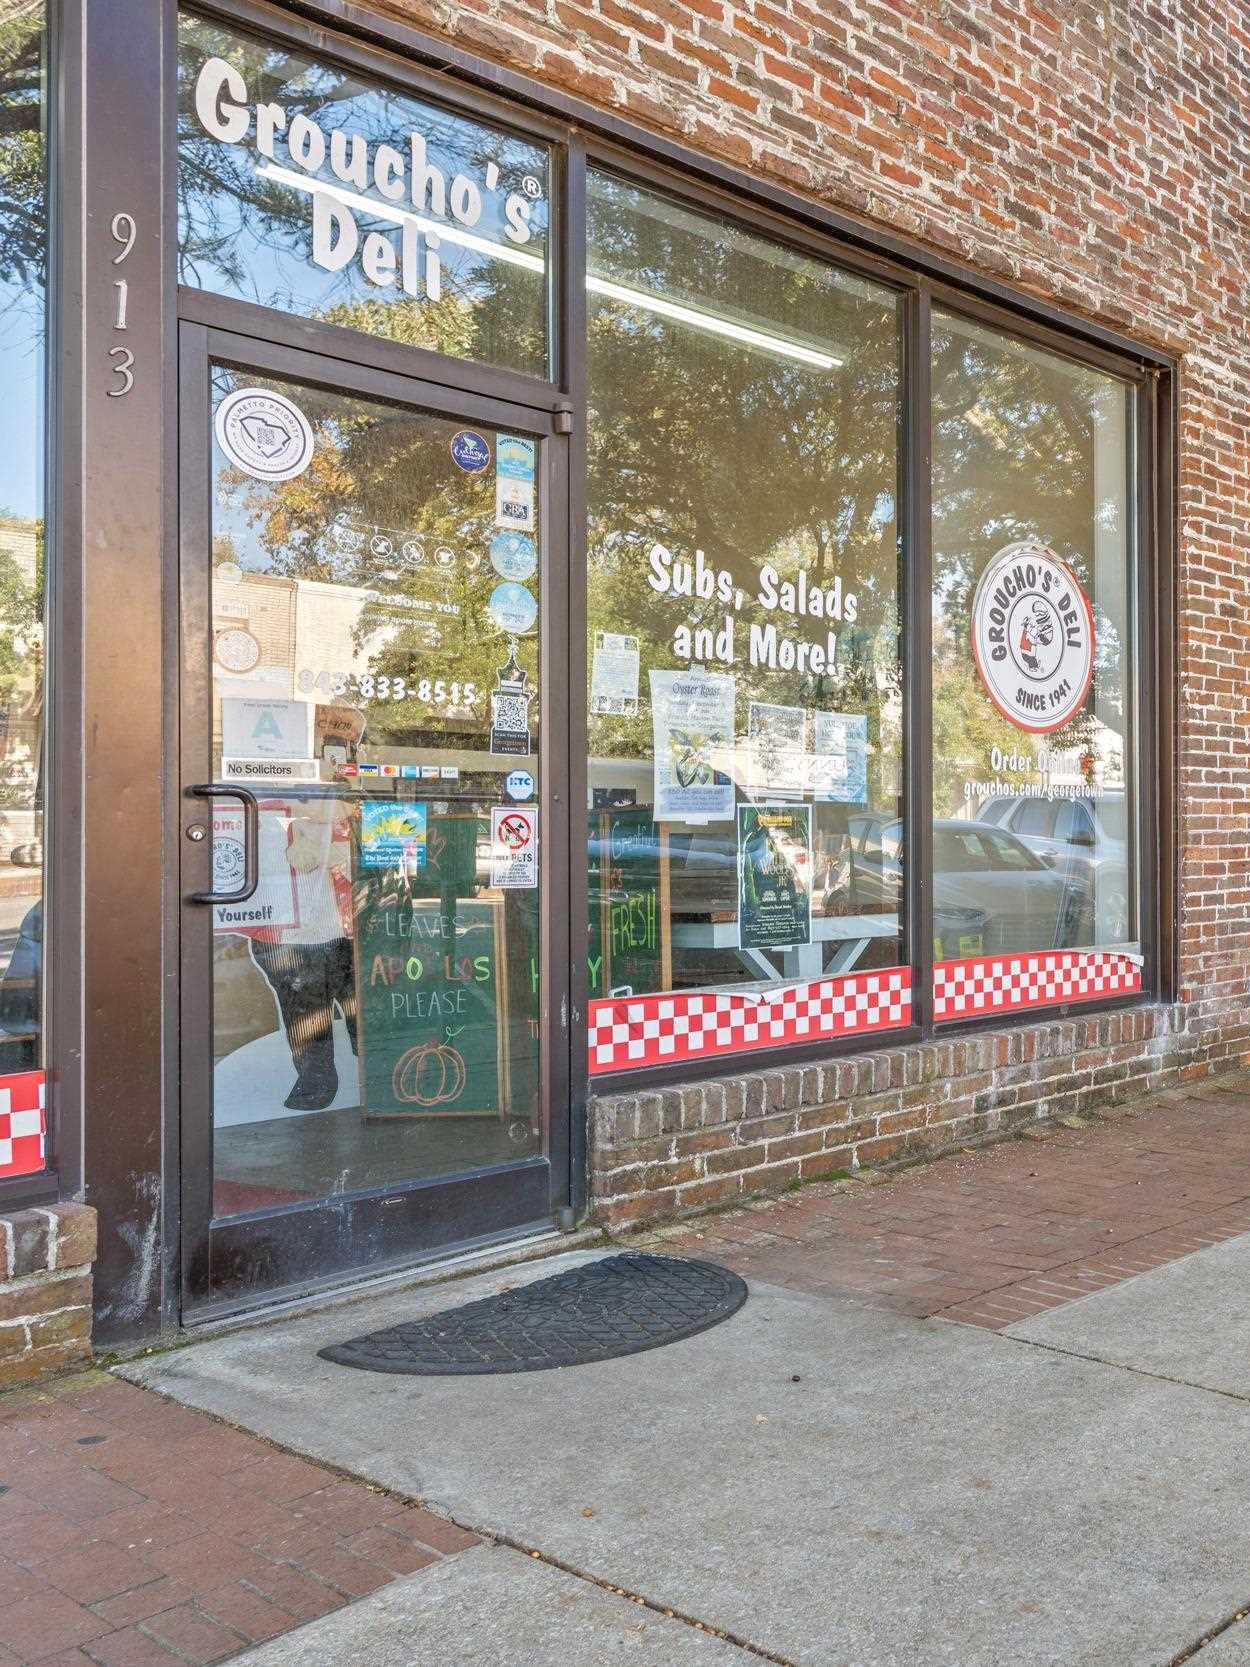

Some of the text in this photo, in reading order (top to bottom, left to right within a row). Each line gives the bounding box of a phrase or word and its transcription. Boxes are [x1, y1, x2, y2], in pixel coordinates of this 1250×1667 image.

[196, 57, 533, 245] Groucho's
[313, 191, 441, 301] Deli
[230, 401, 266, 429] PALMETTO
[648, 543, 859, 623] Subs, Salads
[987, 563, 1053, 663] GROUCHO'S
[1056, 591, 1083, 649] DELI
[673, 615, 838, 676] and More!
[298, 668, 477, 706] 843-833-8515
[1014, 678, 1073, 712] SINCE 1941
[227, 764, 292, 776] No Solicitors
[991, 745, 1033, 773] Order
[217, 905, 272, 922] Yourself
[385, 911, 466, 939] LEAVES
[612, 888, 656, 956] FRESH
[391, 989, 468, 1018] PLEASE
